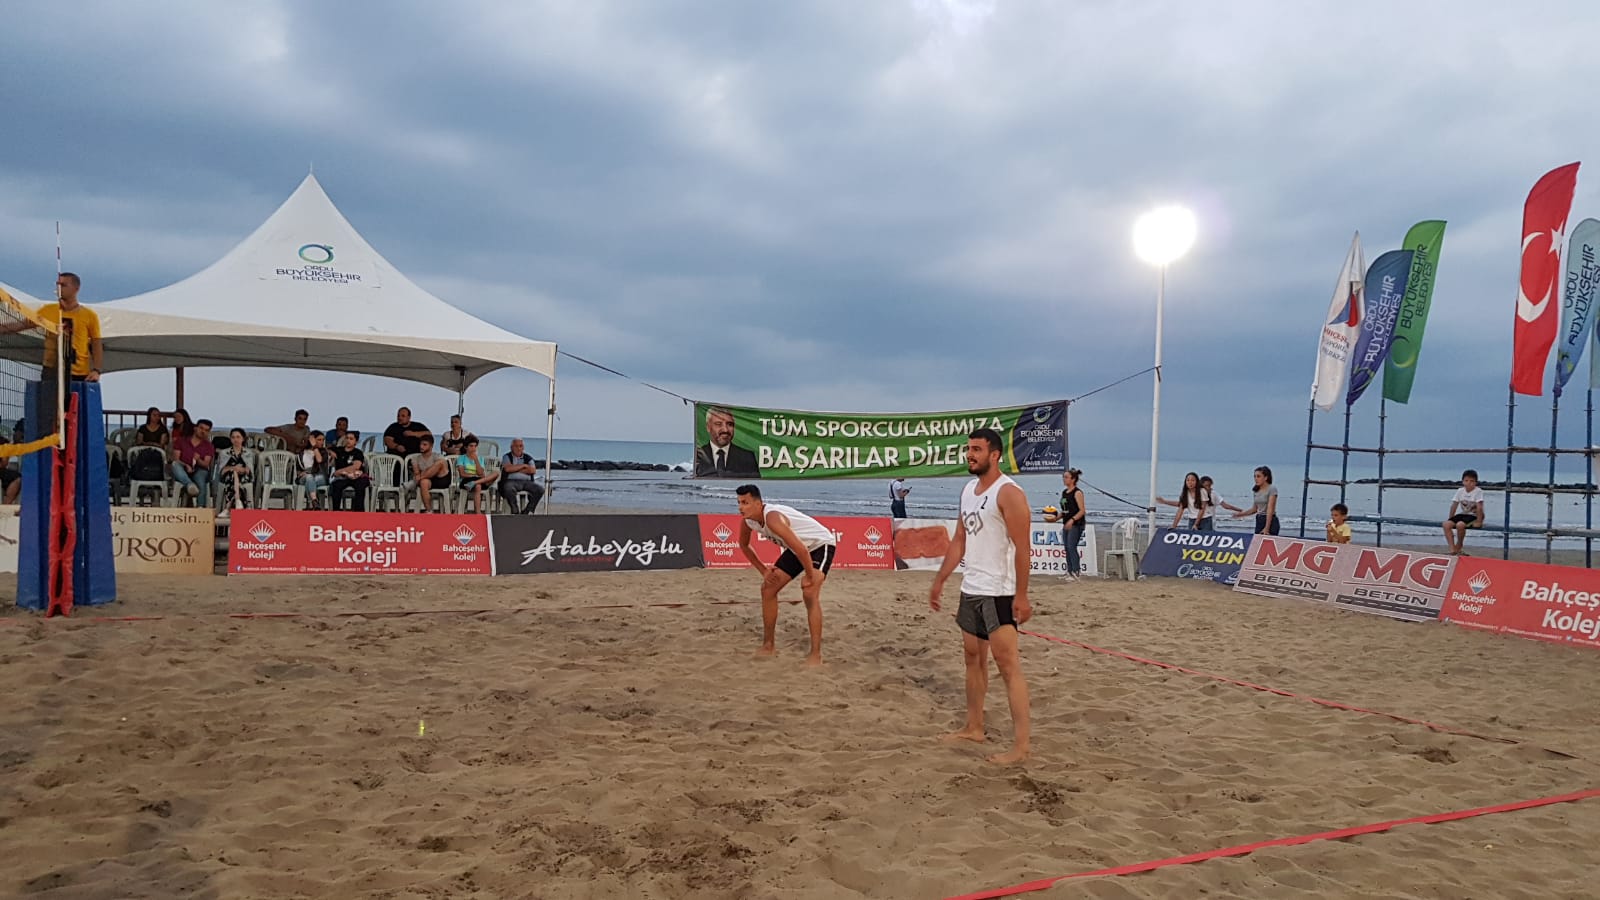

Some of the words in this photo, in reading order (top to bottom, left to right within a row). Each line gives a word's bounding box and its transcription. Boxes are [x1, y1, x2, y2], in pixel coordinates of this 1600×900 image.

[1364, 299, 1378, 331] ORDU
[759, 414, 808, 437] TÜM
[815, 416, 1004, 437] SPORCULARIMIZA
[758, 445, 900, 473] BAŞARILAR
[909, 440, 985, 466] DİLER
[113, 511, 126, 525] iç
[132, 511, 210, 524] bitmesin...
[309, 525, 425, 545] Bahçeşehir
[1032, 530, 1087, 546] CAE
[1164, 532, 1245, 550] ORDU'DA
[112, 532, 198, 562] ÜRSOY
[237, 541, 287, 551] Bahçeşehir
[442, 544, 486, 553] Bahçeşehir
[521, 529, 684, 567] Atabeyoğlu
[714, 549, 734, 557] Koleji
[248, 550, 275, 561] Koleji
[338, 547, 397, 567] Koleji
[453, 552, 476, 562] Koleji
[1253, 537, 1338, 575] MG
[1041, 561, 1059, 570] 212
[1352, 548, 1450, 590] MG
[1254, 573, 1319, 590] BETON
[1354, 587, 1428, 606] BETON
[1452, 591, 1497, 605] Bahçeşehir
[1520, 580, 1600, 611] Bahçeş
[1458, 602, 1483, 615] Koleji
[1541, 608, 1600, 640] Kolej
